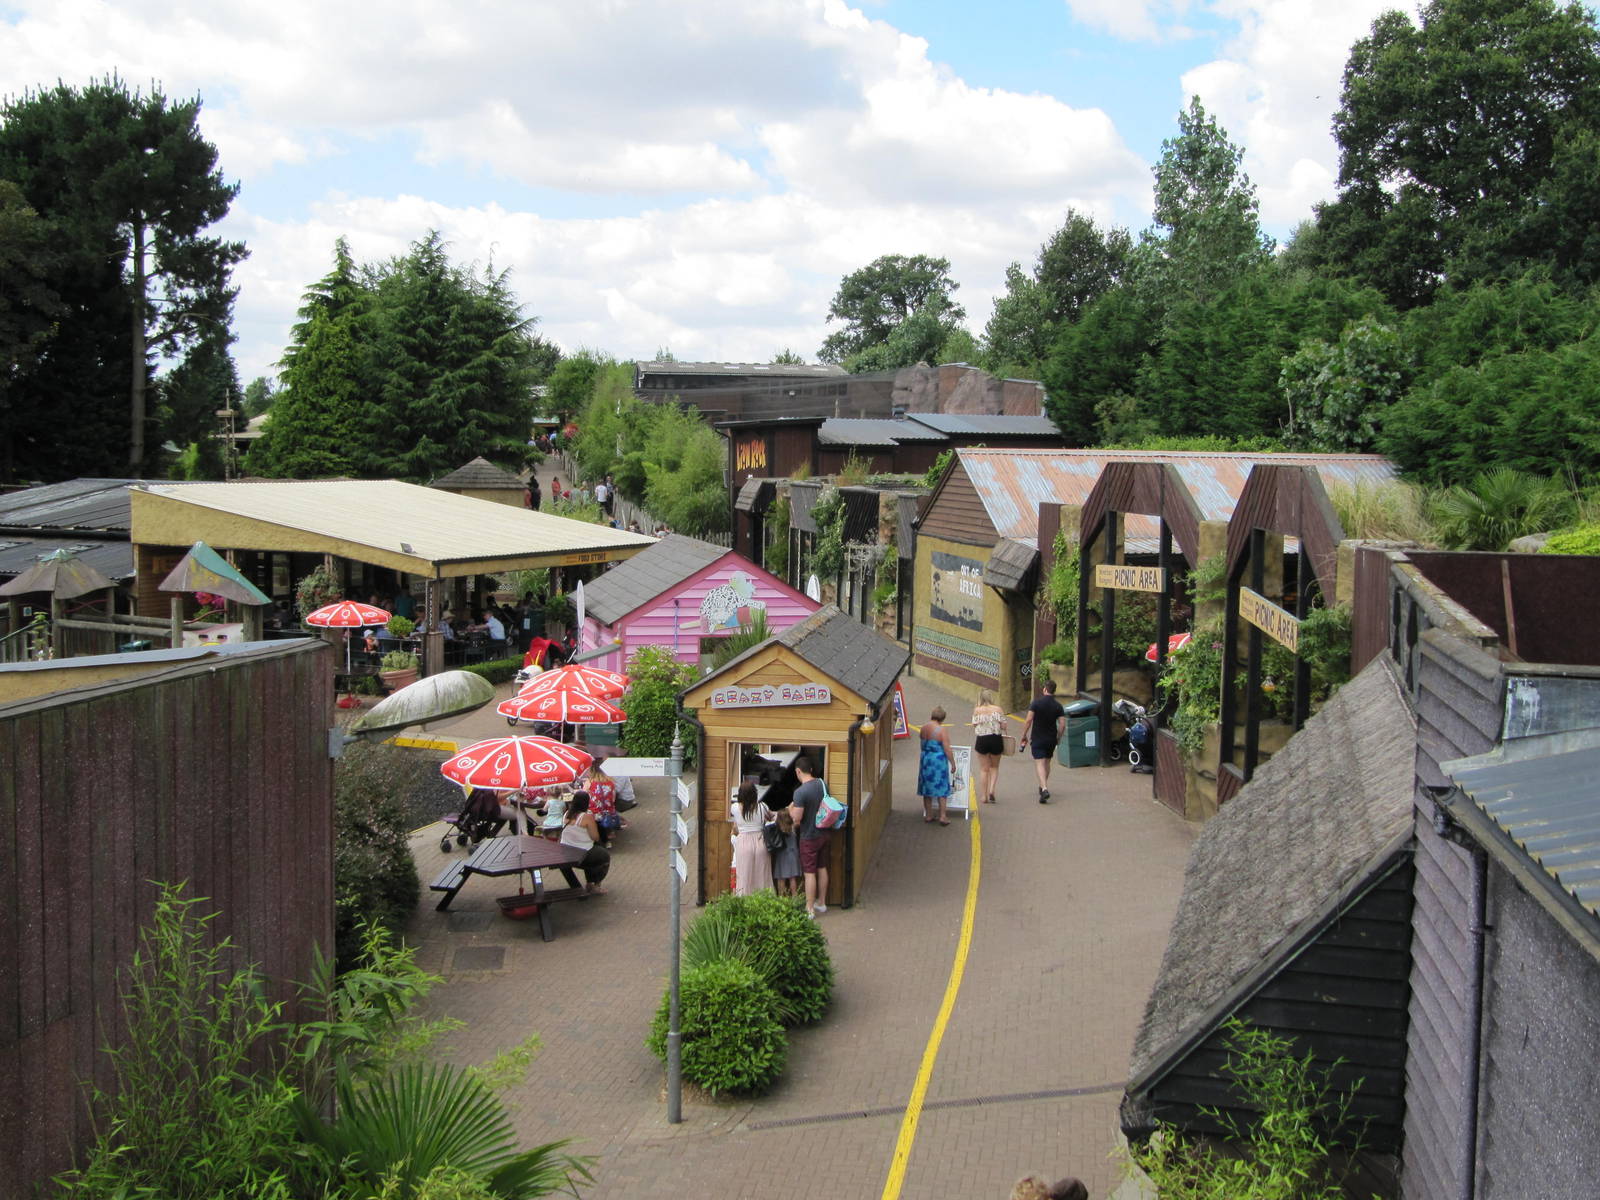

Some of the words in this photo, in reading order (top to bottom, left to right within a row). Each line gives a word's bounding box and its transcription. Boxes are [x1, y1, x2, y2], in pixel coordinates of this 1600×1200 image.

[960, 564, 970, 577] OUT
[1114, 569, 1136, 588] PICNIC
[1139, 569, 1158, 590] AREA
[959, 578, 983, 600] AFRICA
[1255, 601, 1275, 633] PICNIC
[1276, 613, 1296, 650] AREA
[715, 689, 774, 705] CRAZY
[782, 687, 828, 702] SAND
